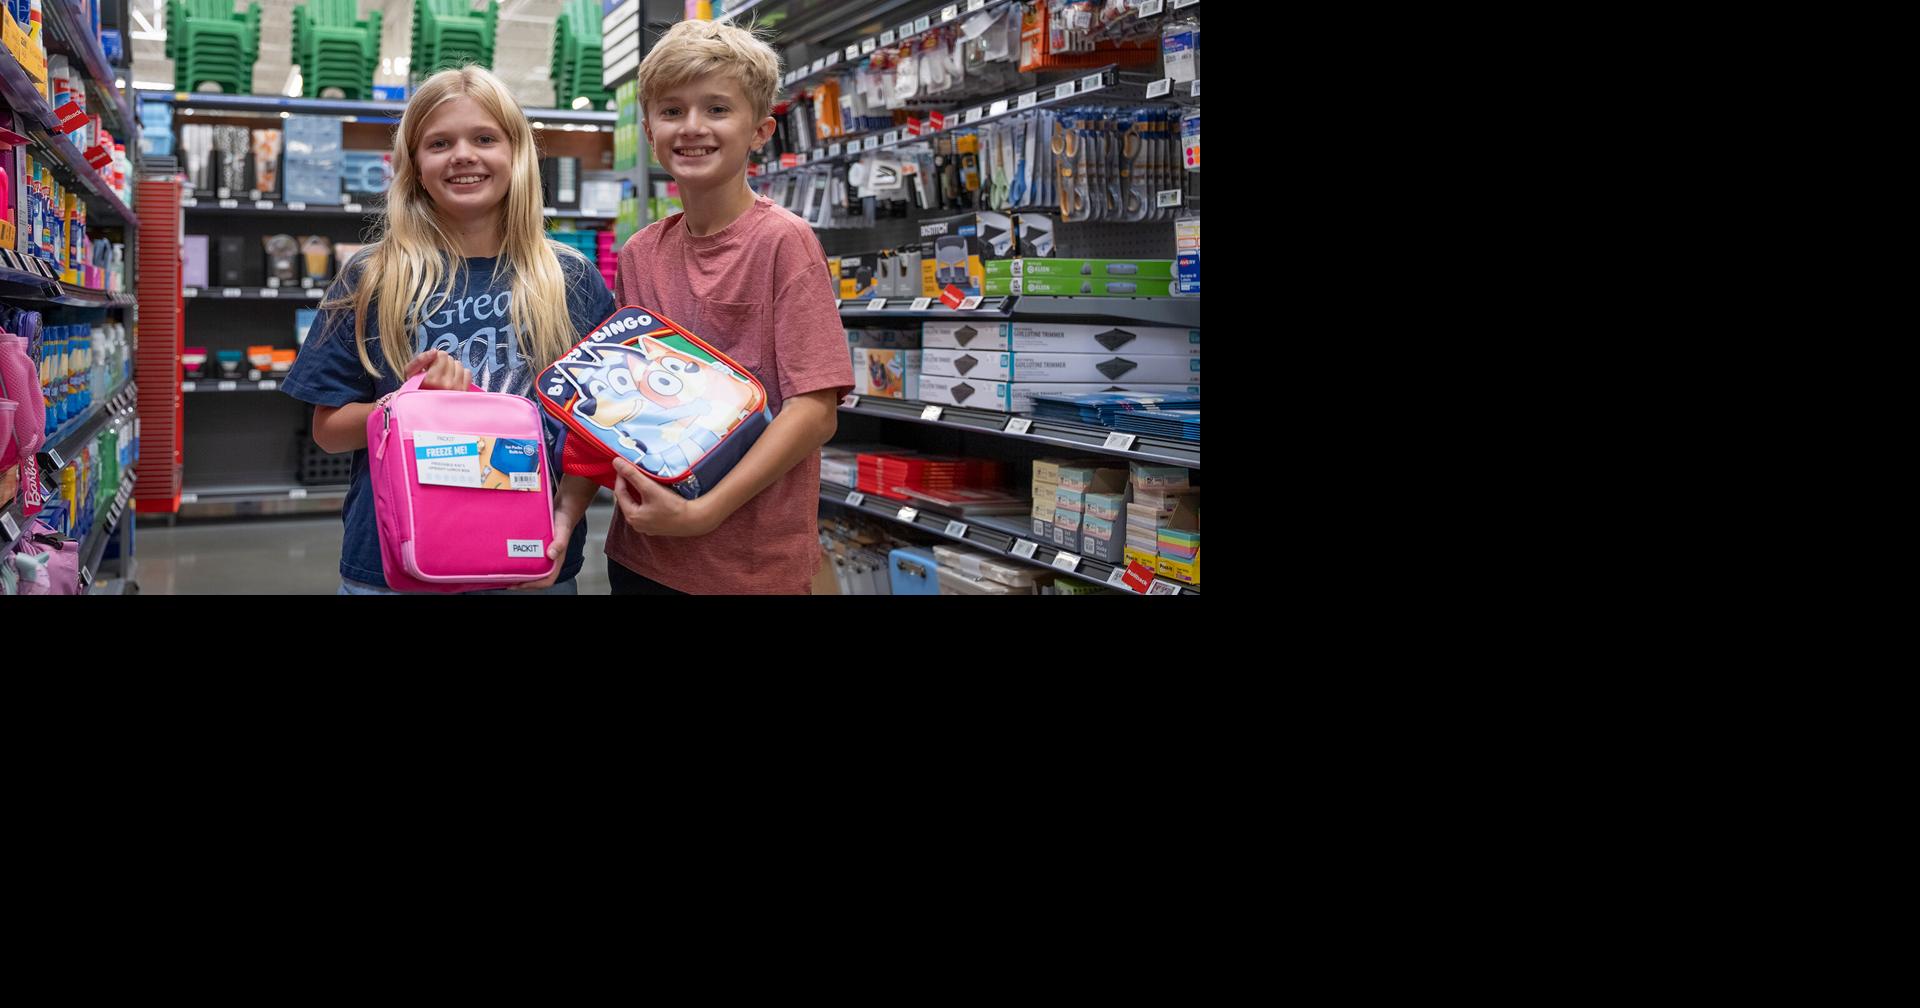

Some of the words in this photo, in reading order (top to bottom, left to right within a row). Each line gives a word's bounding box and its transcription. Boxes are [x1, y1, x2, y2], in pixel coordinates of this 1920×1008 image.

[921, 223, 949, 237] BOSTITCH
[590, 315, 652, 342] BINGO
[1043, 361, 1066, 369] TRIMMER
[426, 446, 453, 457] FREEZE
[454, 445, 468, 456] ME!
[24, 454, 41, 508] Barbie
[1126, 568, 1148, 587] Rollback
